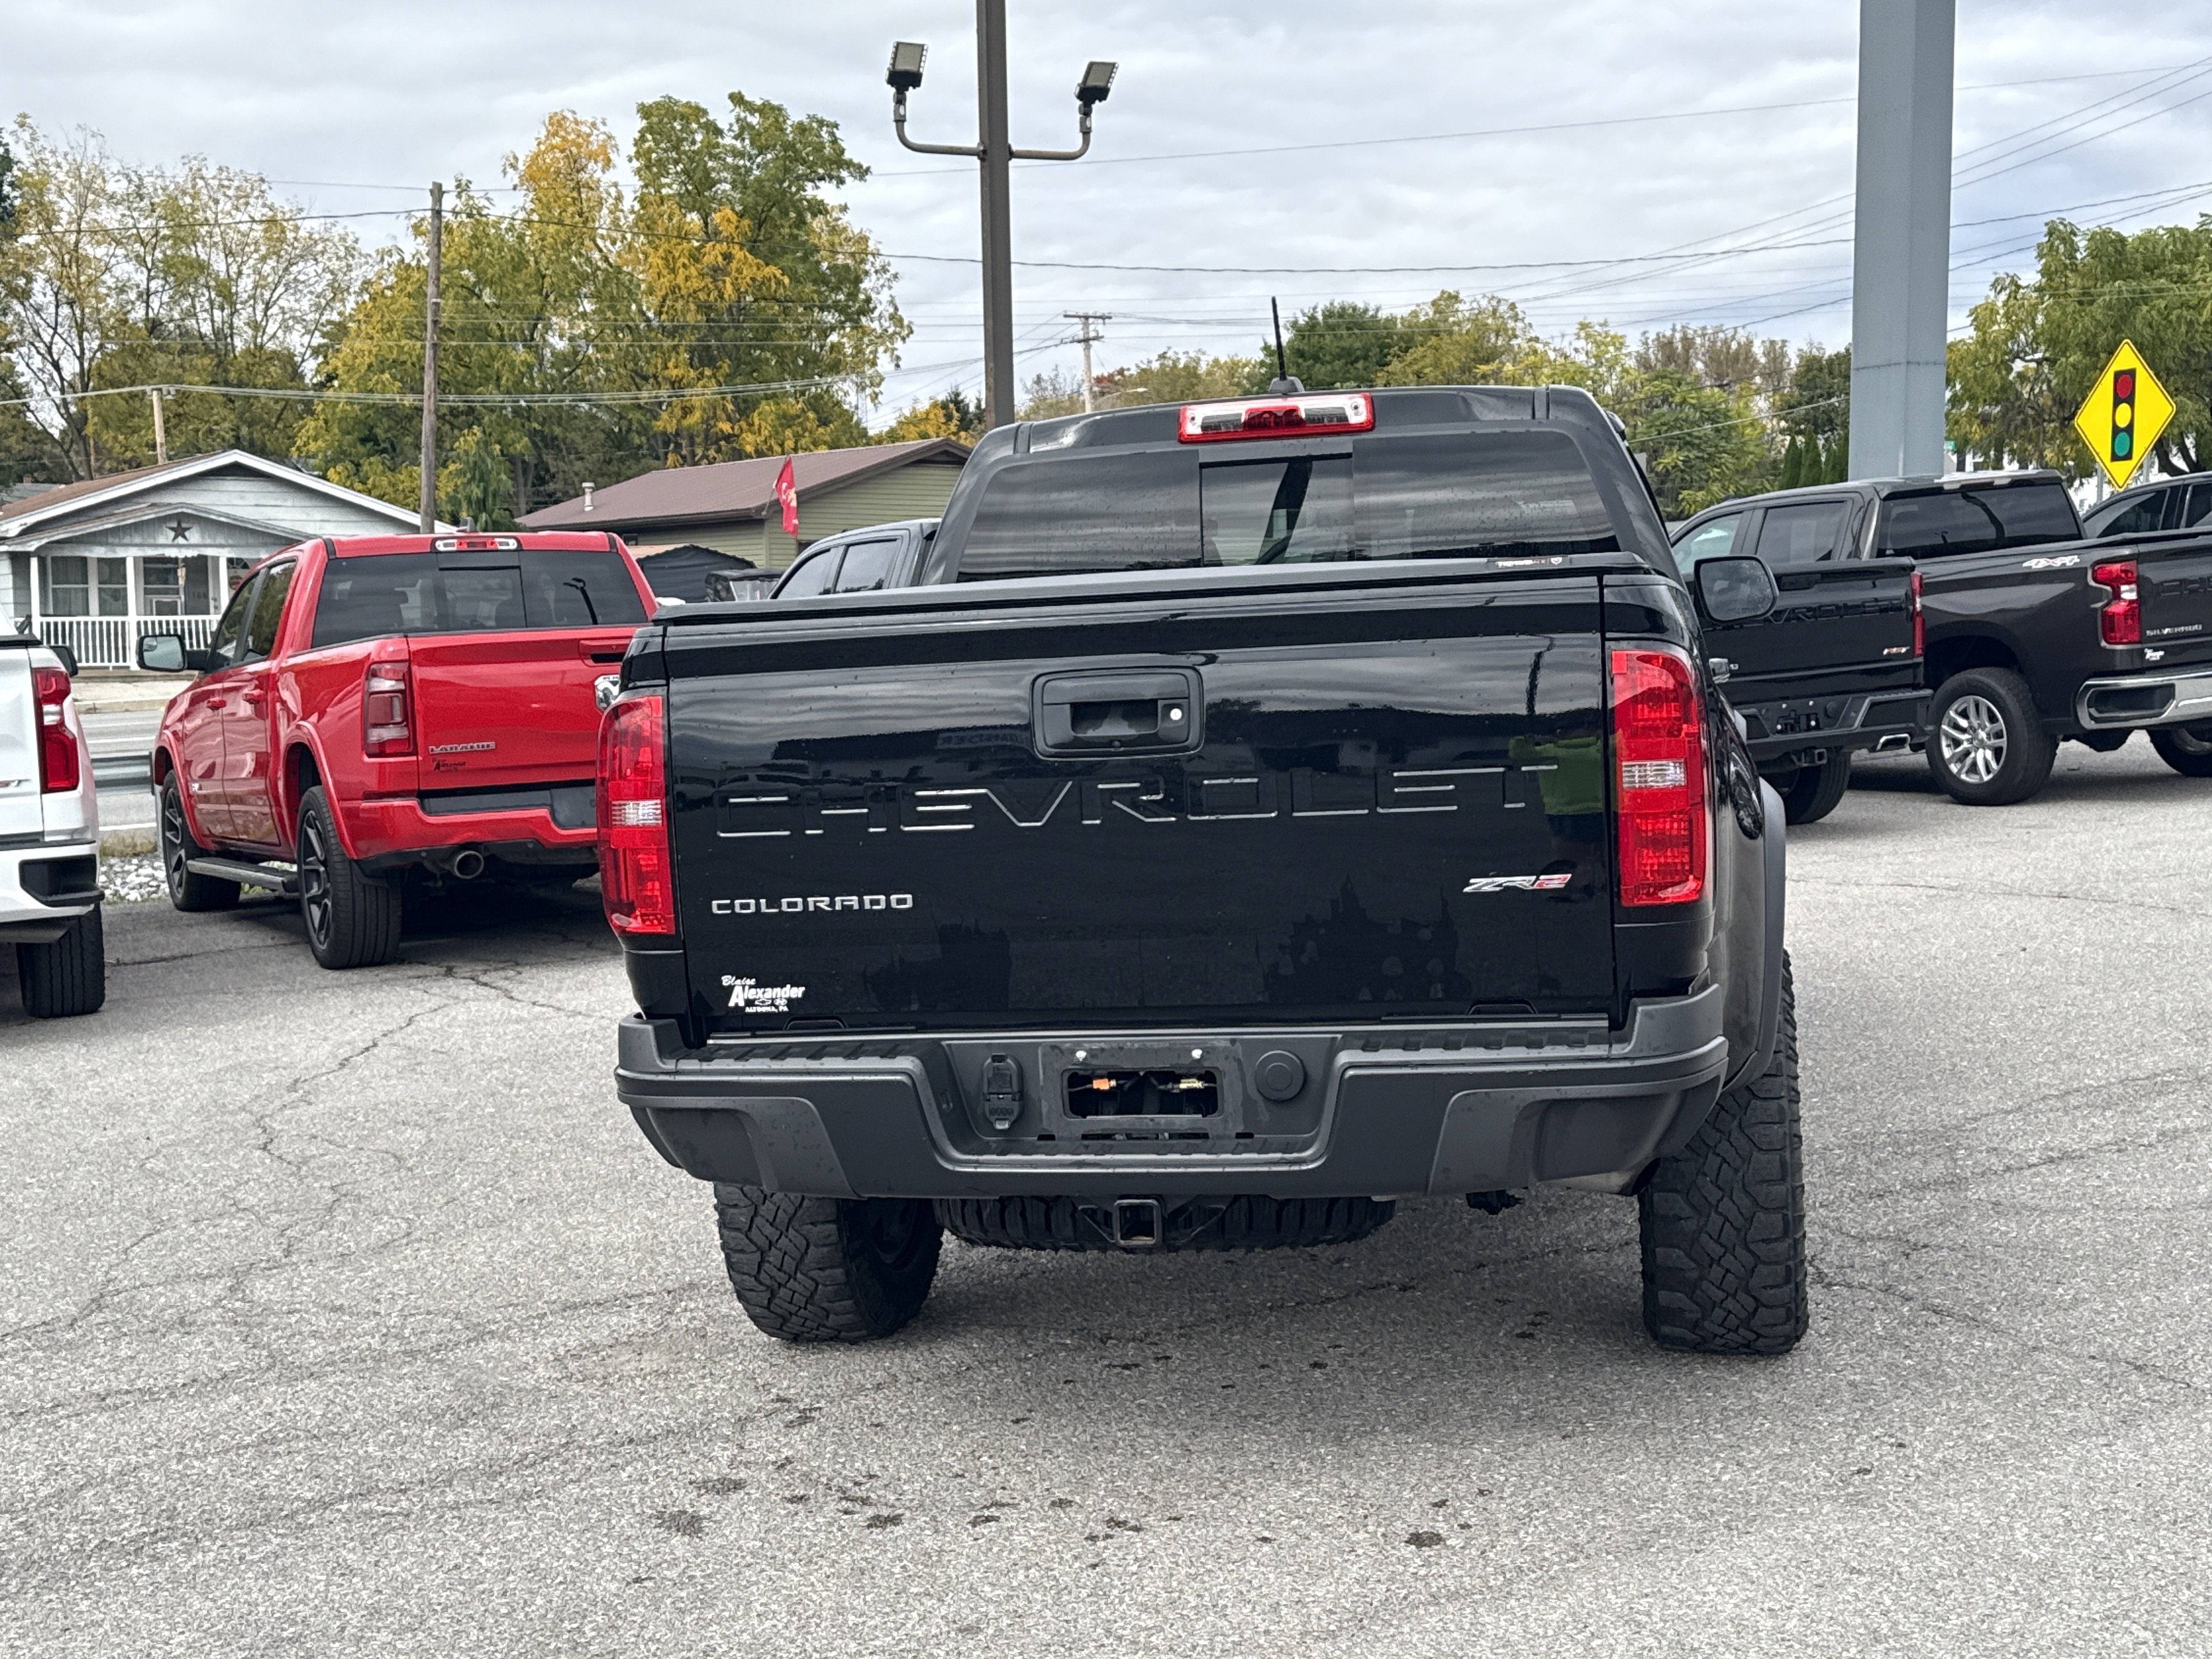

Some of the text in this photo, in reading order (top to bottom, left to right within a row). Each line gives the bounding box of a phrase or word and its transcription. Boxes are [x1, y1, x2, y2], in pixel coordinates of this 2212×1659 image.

[716, 765, 1559, 837] CHEVROLET
[1463, 874, 1572, 893] ZR2
[712, 894, 913, 914] COLORADO
[721, 975, 757, 986] Blaise
[728, 984, 805, 1006] Alexander
